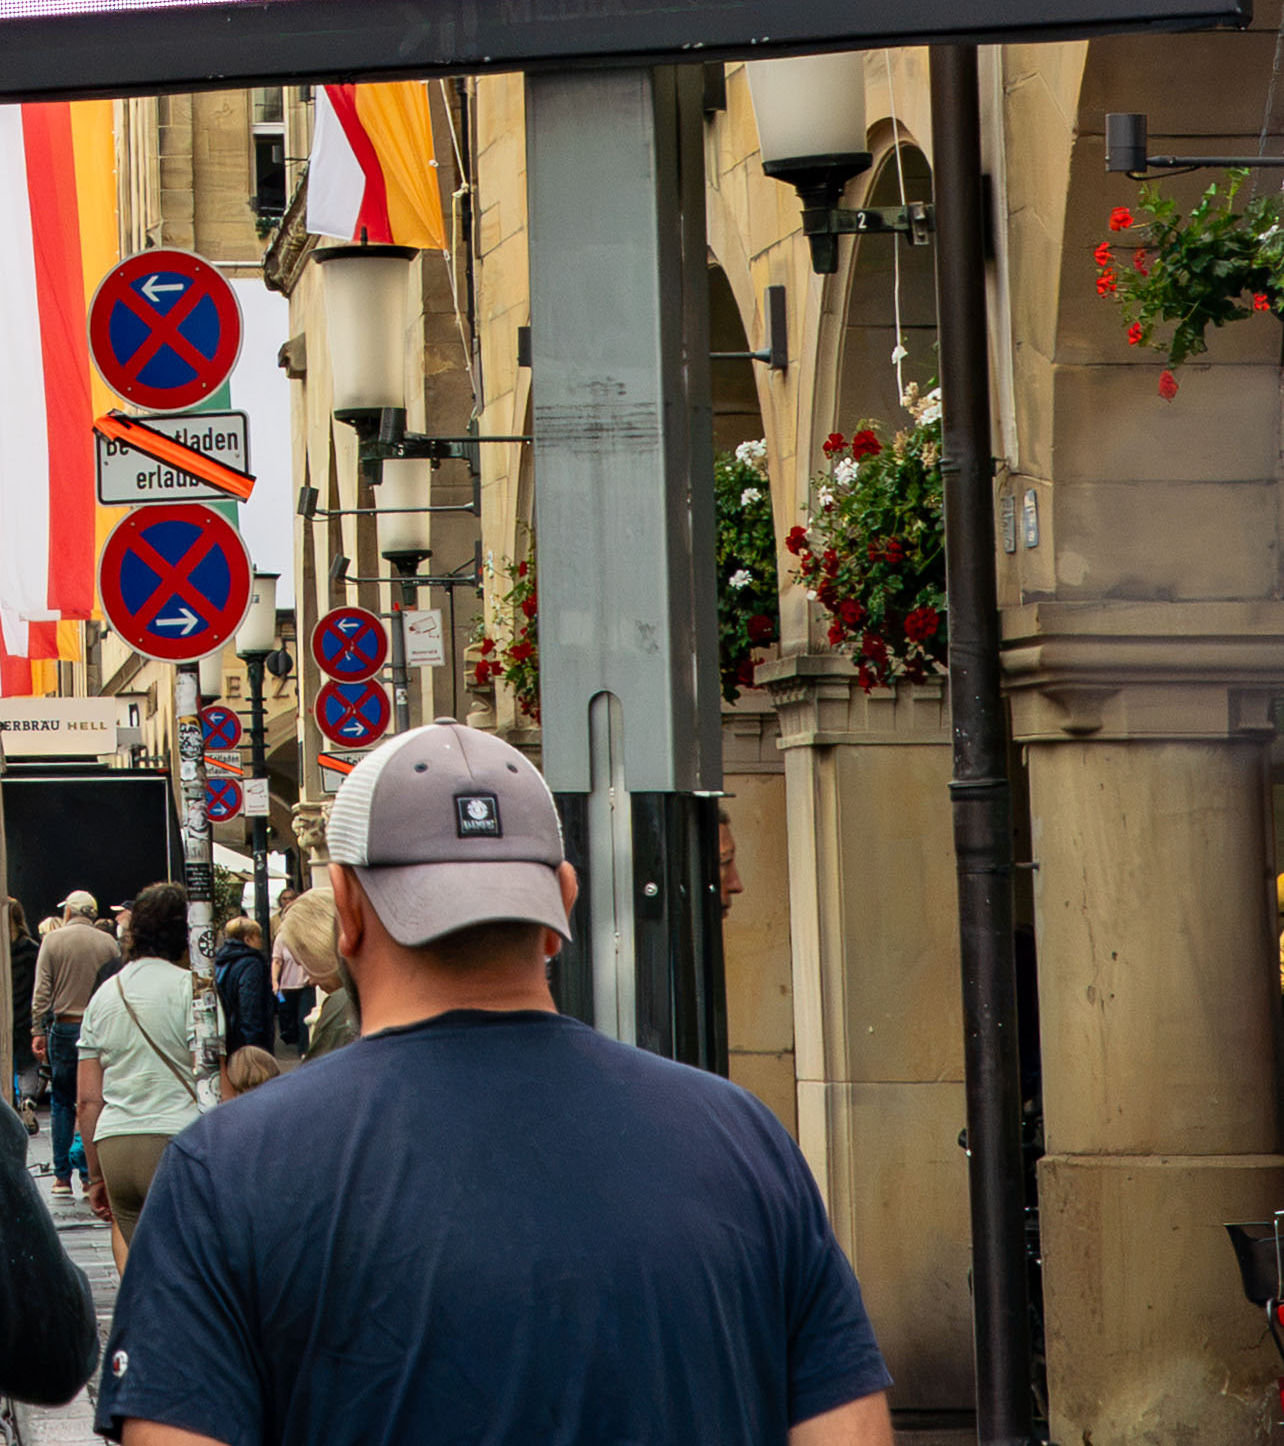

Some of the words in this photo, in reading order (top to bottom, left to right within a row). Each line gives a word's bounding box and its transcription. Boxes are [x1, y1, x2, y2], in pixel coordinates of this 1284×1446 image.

[857, 211, 867, 229] 2
[136, 465, 204, 489] erlaub
[1, 719, 59, 731] ERBRÄU
[67, 721, 108, 731] HELL
